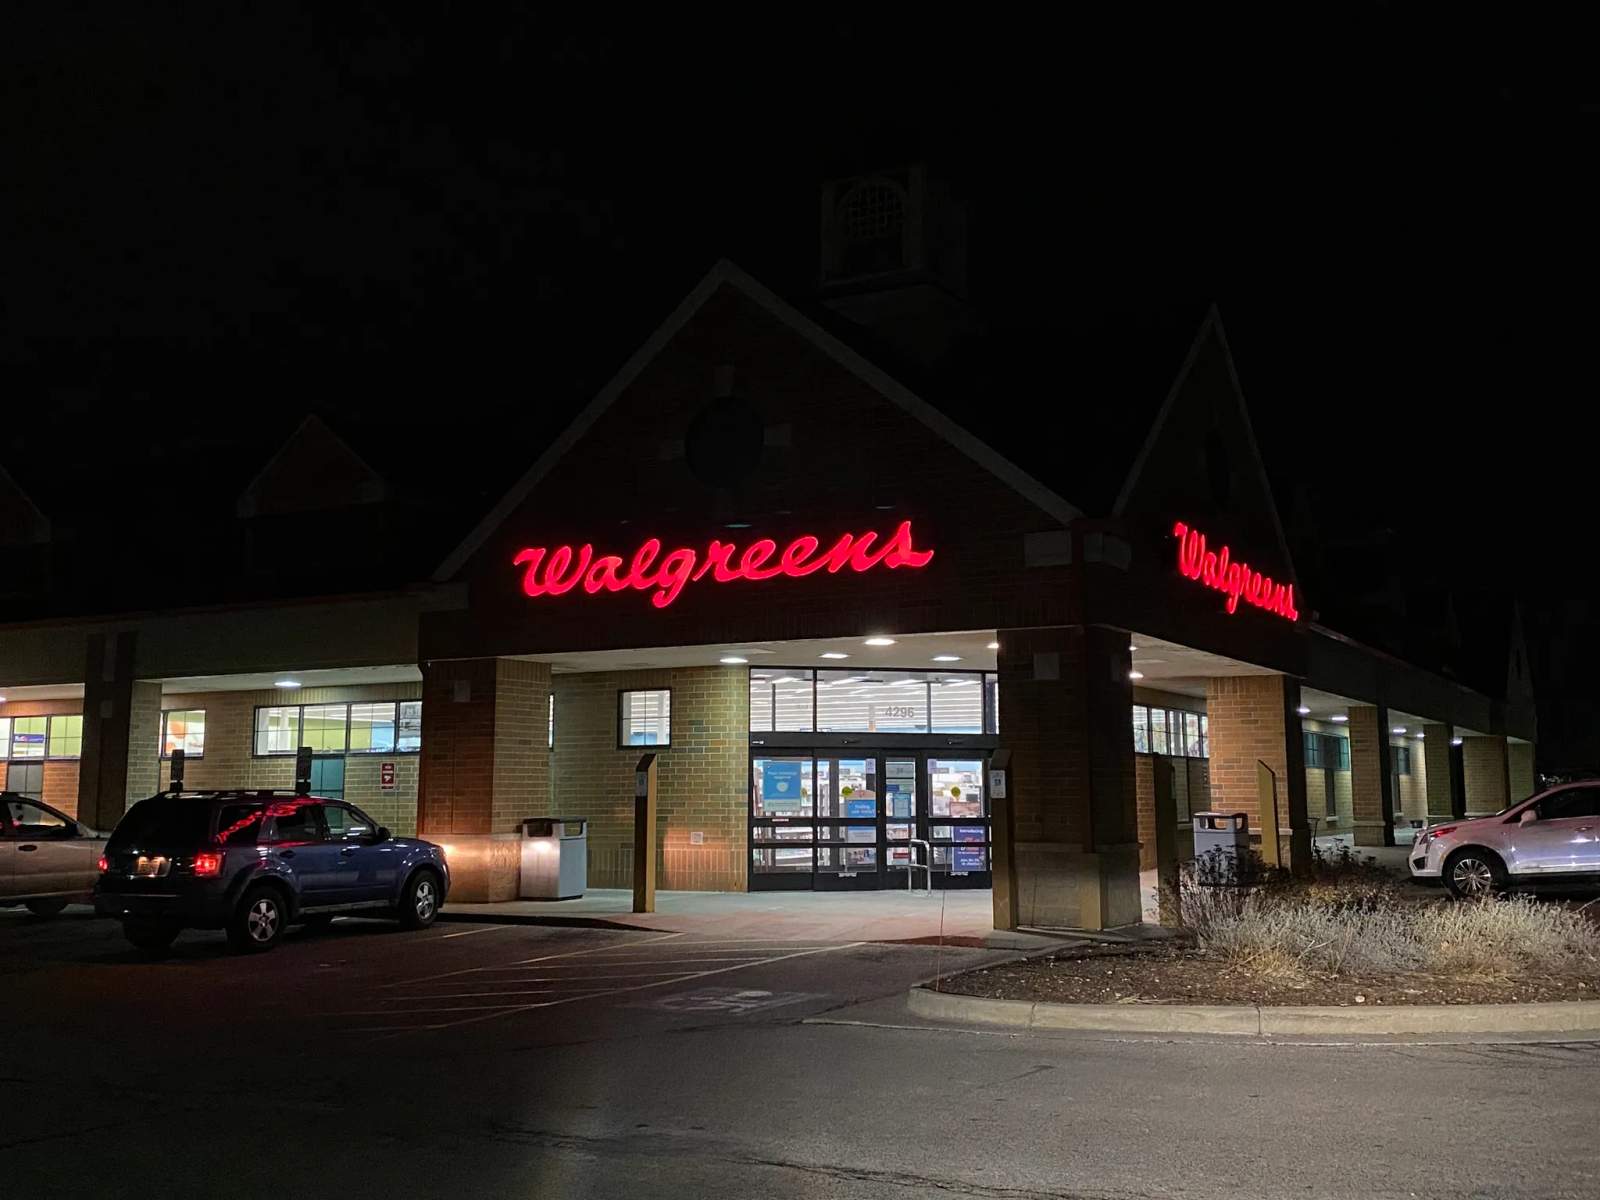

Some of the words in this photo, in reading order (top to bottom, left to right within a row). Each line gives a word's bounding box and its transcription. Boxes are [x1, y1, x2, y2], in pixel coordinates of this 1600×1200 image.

[512, 520, 934, 608] Walgreens
[1173, 521, 1298, 621] Walgreens
[885, 706, 914, 718] 4296
